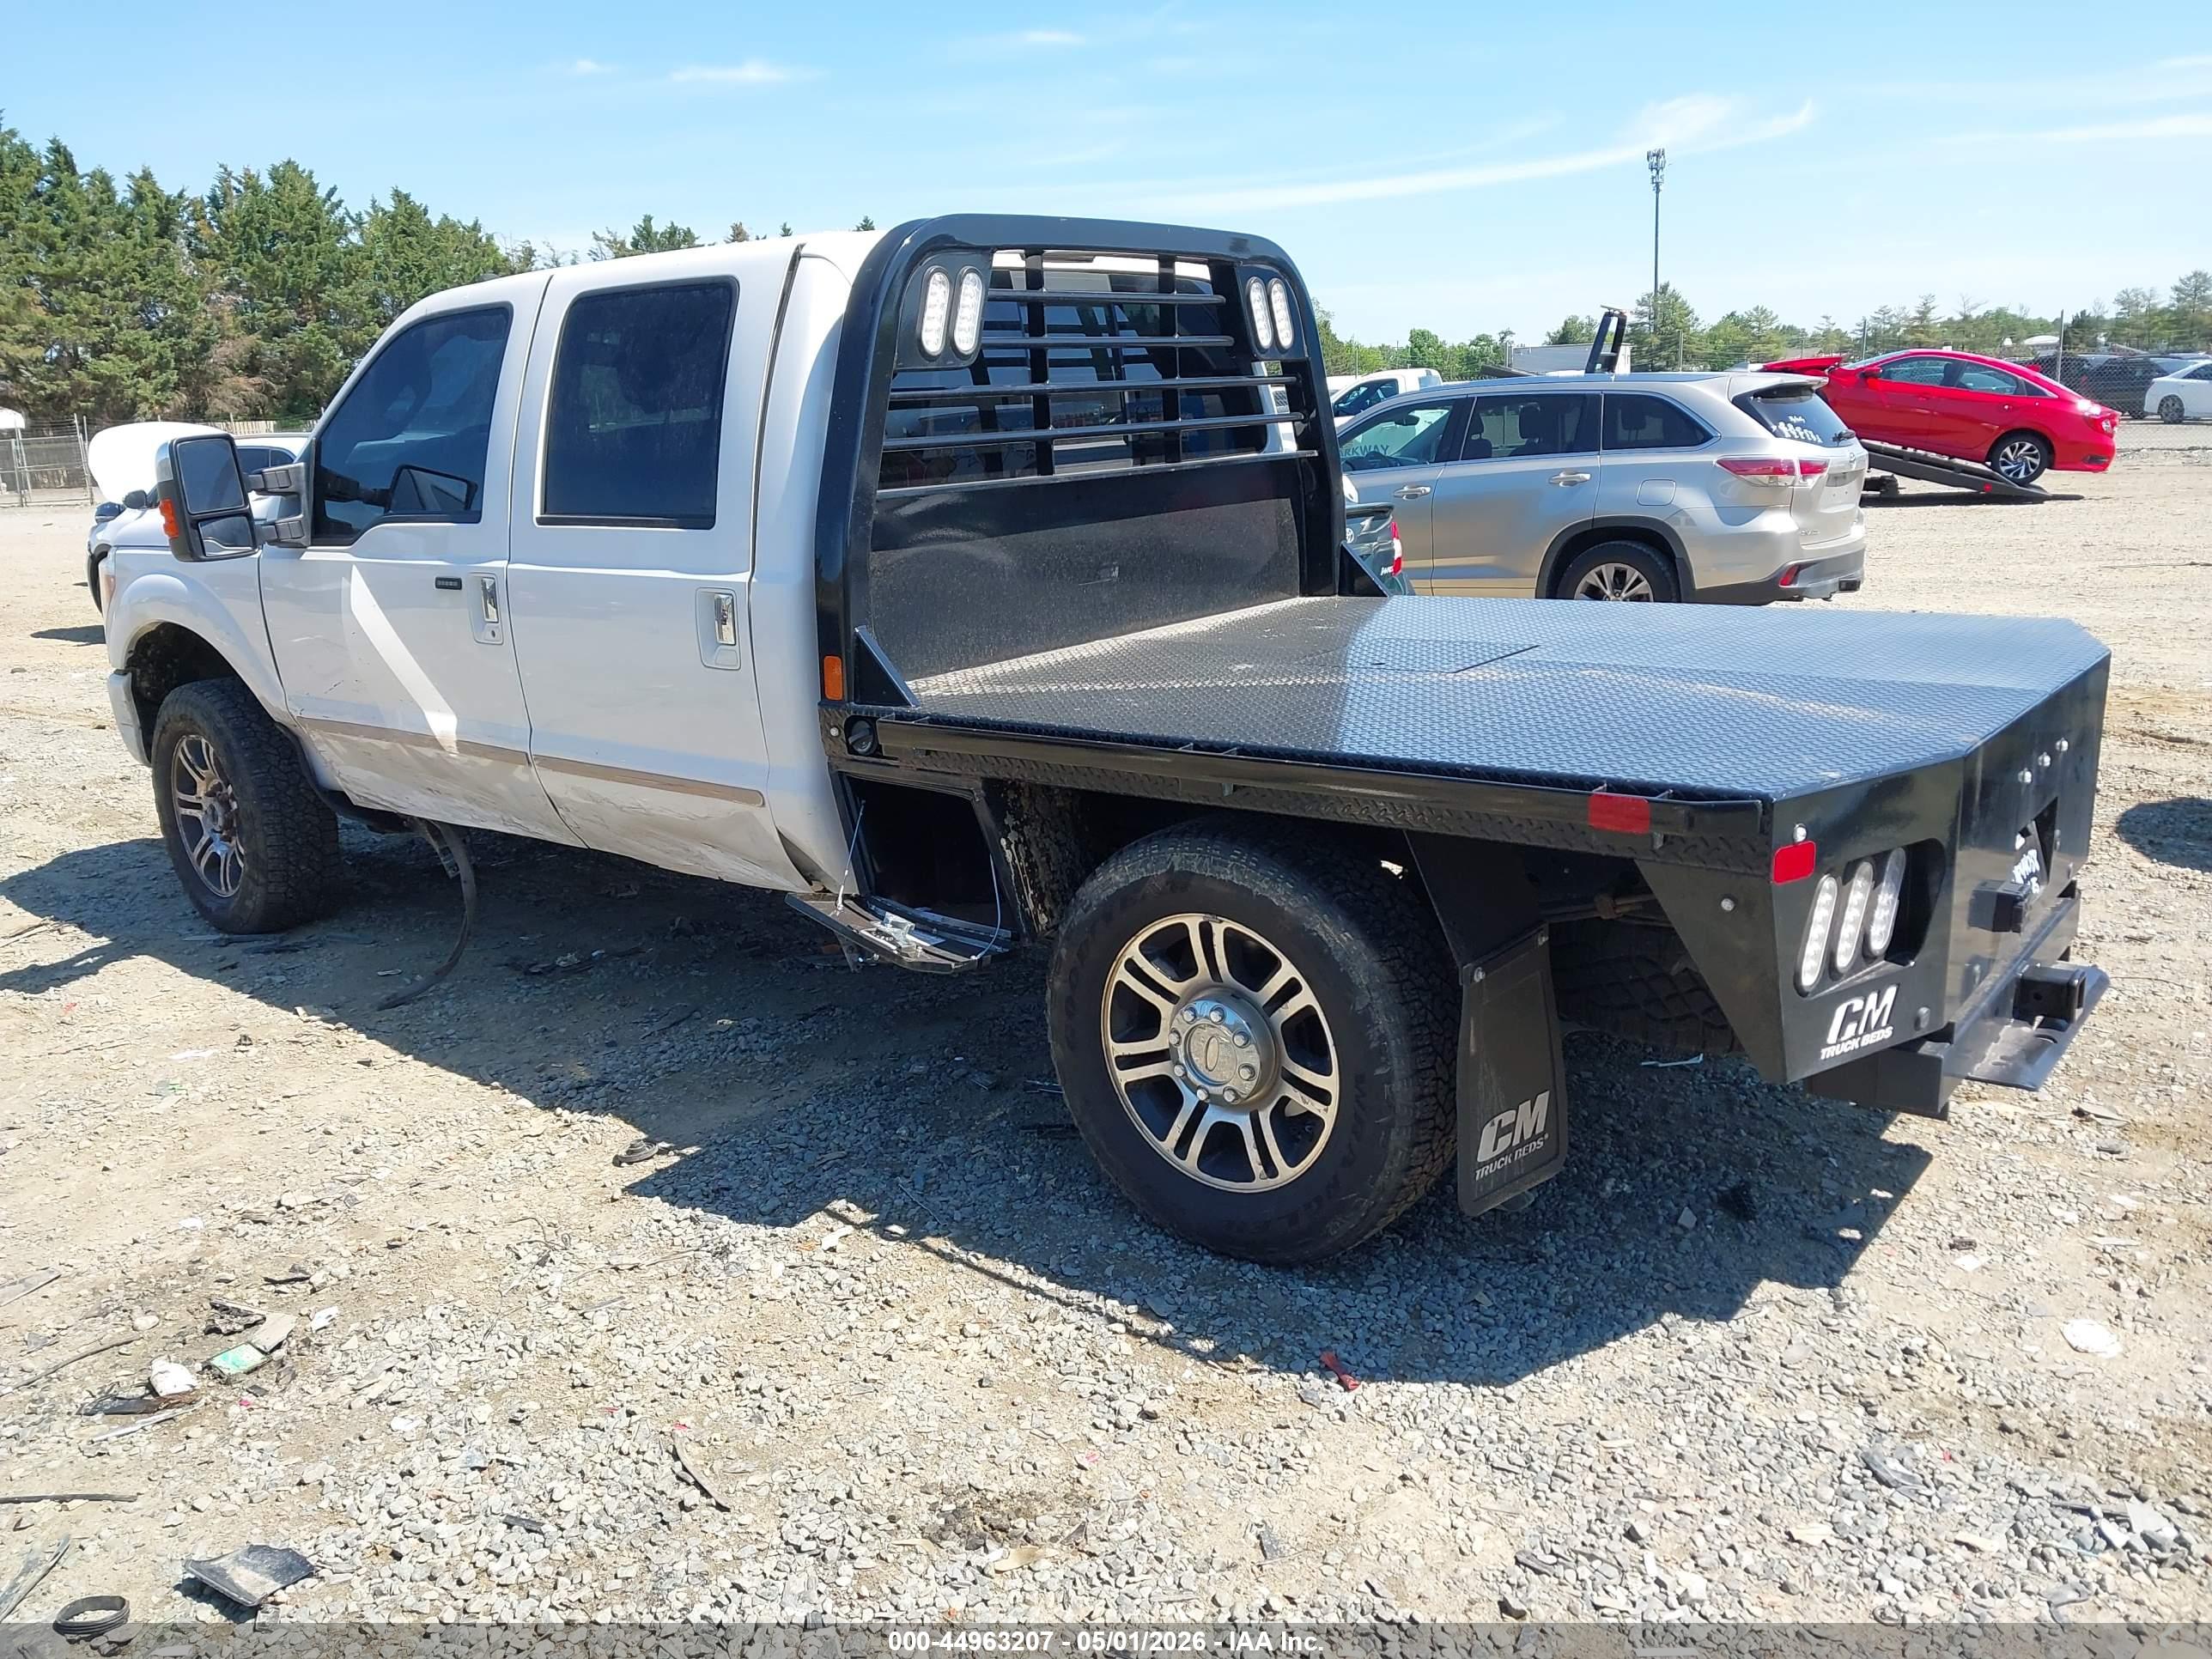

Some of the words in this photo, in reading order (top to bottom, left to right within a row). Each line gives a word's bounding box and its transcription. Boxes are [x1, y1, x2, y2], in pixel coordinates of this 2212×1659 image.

[1826, 985, 1897, 1044] CM
[1820, 1037, 1861, 1060] TRUCK
[1860, 1026, 1893, 1047] BEDS
[1477, 1091, 1550, 1163] CM
[1475, 1154, 1512, 1181] TRUCK
